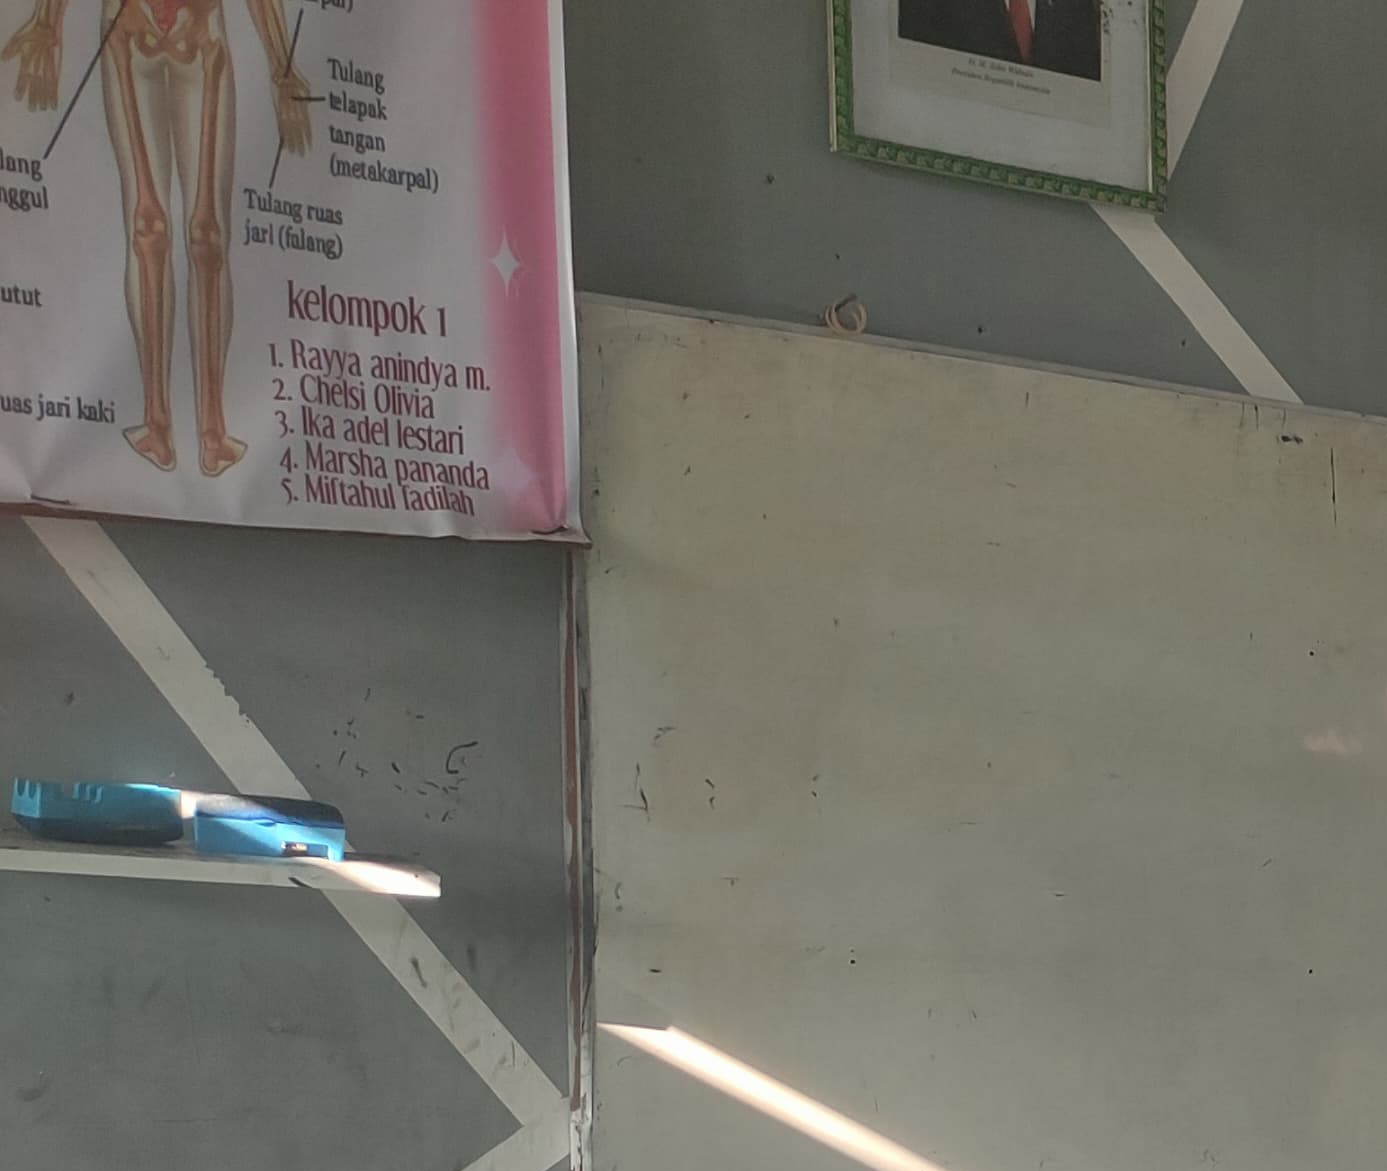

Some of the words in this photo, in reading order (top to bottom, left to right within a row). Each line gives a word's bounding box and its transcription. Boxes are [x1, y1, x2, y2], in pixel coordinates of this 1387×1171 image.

[327, 58, 386, 95] Tulang
[328, 90, 388, 122] telapak
[329, 124, 386, 153] tangan
[330, 152, 439, 194] (metakarpal)
[243, 187, 303, 224] Tulang
[307, 204, 343, 225] ruas
[243, 218, 274, 246] jari
[278, 224, 343, 260] (falang)
[287, 279, 427, 337] kelompok
[437, 306, 448, 337] 1
[268, 343, 284, 368] 1.
[290, 338, 362, 380] Rayya
[370, 352, 458, 392] anindya
[465, 365, 491, 392] m.
[36, 393, 71, 421] jari
[77, 396, 116, 424] kaki
[272, 378, 293, 402] 2.
[300, 373, 367, 412] Chelsi
[374, 382, 435, 420] Olivia
[274, 410, 295, 438] 3.
[301, 405, 336, 440] Ika
[343, 415, 390, 448] adel
[397, 419, 464, 455] lestari
[279, 446, 299, 474] 4.
[305, 439, 388, 480] Marsha
[394, 458, 490, 491] pananda
[281, 477, 299, 505] 5.
[304, 473, 397, 511] Miftahul
[401, 484, 475, 517] fadilah
